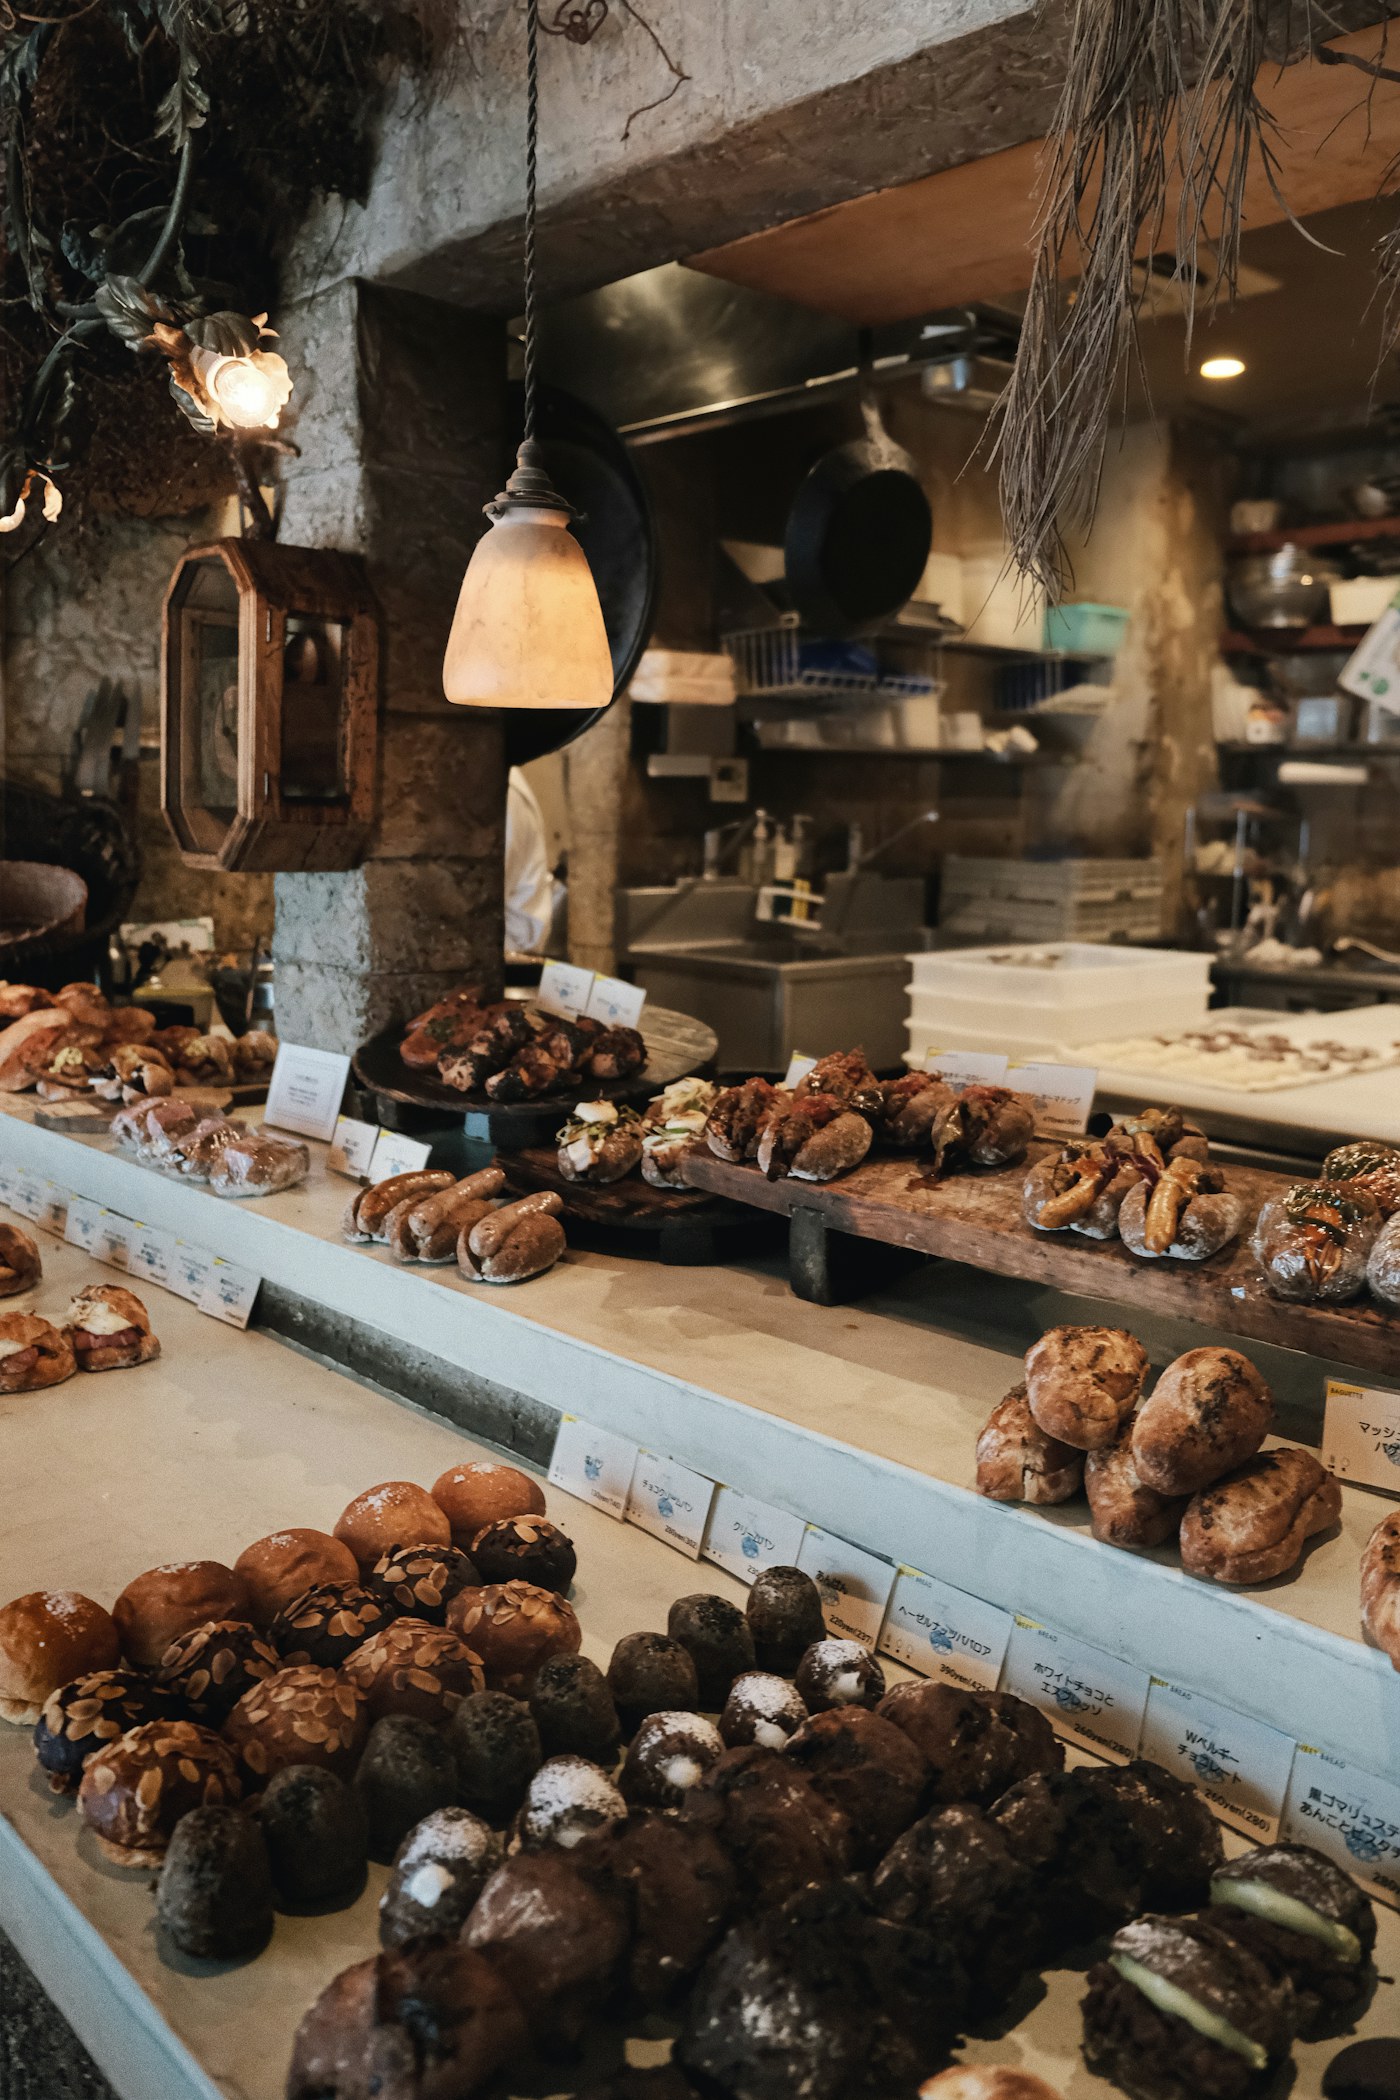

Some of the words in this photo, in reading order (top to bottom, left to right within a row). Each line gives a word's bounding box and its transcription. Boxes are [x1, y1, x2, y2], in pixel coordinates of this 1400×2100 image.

[733, 1521, 775, 1550] クリームパン
[1038, 1630, 1058, 1642] BREAD
[1034, 1662, 1114, 1707] ホワイトチョコと
[1170, 1685, 1192, 1701] BREAD
[1185, 1728, 1240, 1763] Wベルギー
[1320, 1752, 1346, 1769] BREAD
[1177, 1744, 1242, 1784] チョコレート
[1204, 1788, 1271, 1832] 260yen(280)
